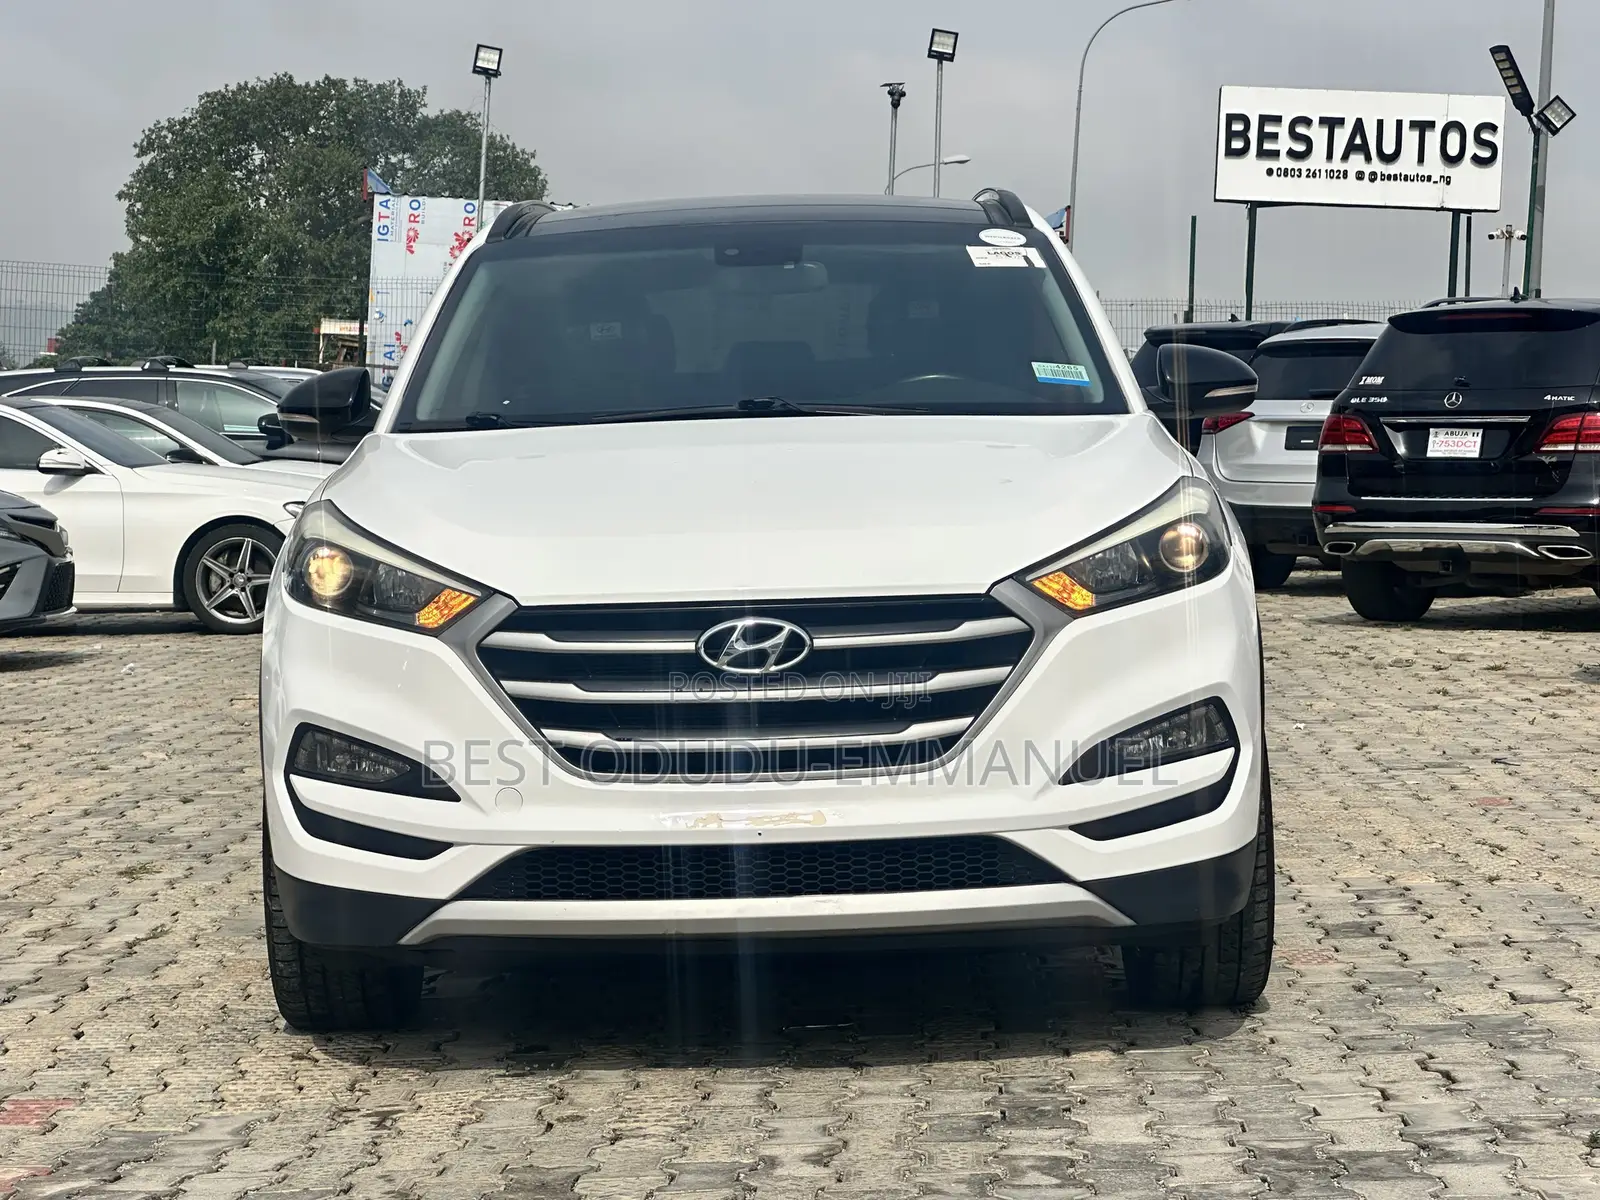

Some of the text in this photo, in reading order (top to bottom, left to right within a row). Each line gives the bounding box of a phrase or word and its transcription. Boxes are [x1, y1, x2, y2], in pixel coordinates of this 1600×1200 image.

[1224, 113, 1499, 166] BESTAUTOS
[1276, 167, 1302, 178] 0803
[1305, 168, 1322, 179] 261
[1325, 169, 1349, 180] 1028
